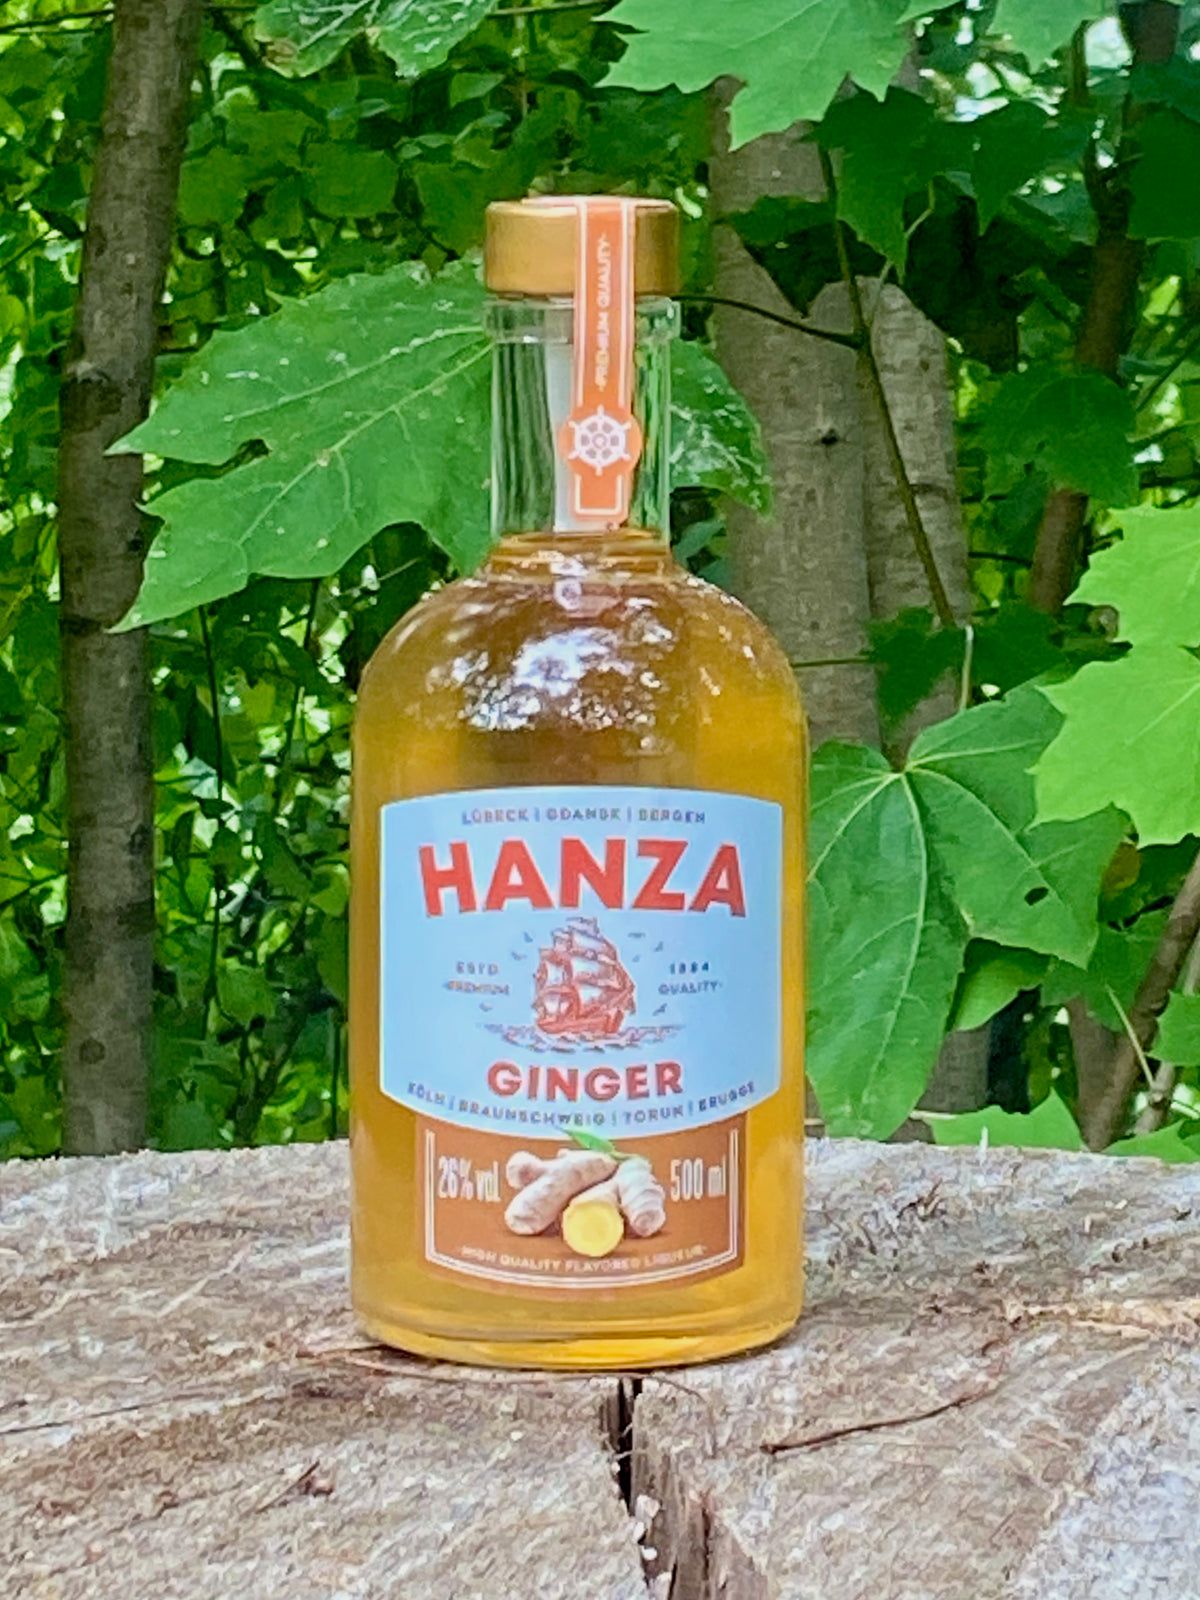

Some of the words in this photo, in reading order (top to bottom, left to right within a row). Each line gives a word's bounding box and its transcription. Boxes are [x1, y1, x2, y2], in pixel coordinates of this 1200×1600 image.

[418, 837, 746, 918] HANZA
[486, 1060, 684, 1102] GINGER
[670, 1157, 704, 1201] 500
[708, 1158, 726, 1196] ml
